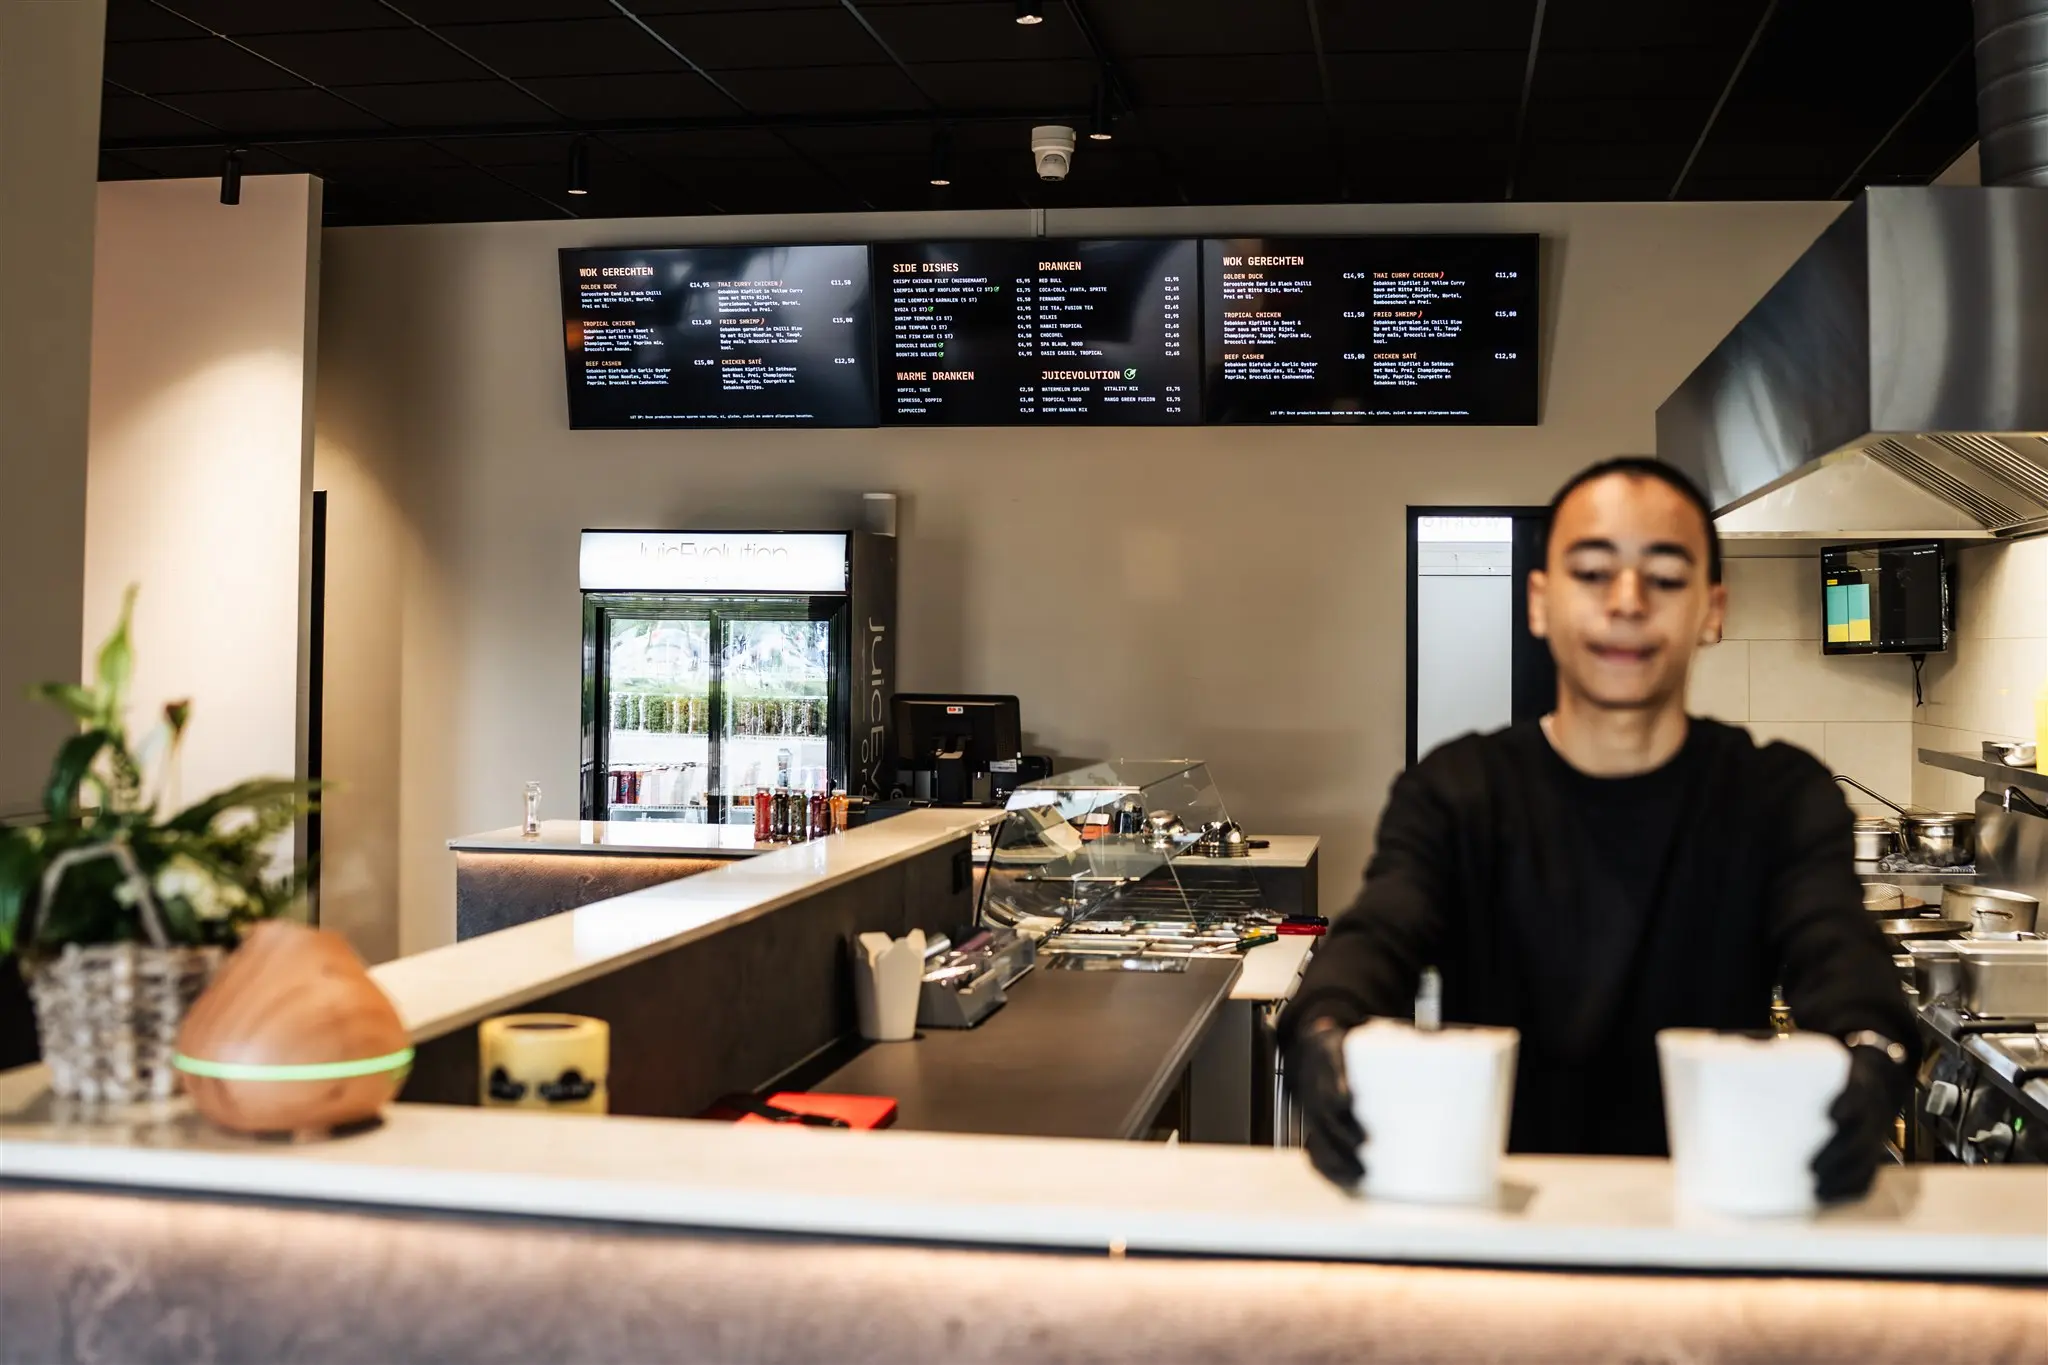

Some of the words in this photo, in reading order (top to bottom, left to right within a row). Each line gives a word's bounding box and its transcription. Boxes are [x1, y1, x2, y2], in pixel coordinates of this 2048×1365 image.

[1223, 257, 1241, 266] WOK
[1248, 257, 1304, 265] GERECHTEN
[602, 268, 653, 276] GERECHTEN
[893, 264, 917, 272] SIDE
[923, 264, 958, 272] DISHES
[1042, 371, 1120, 379] JUICEVOLUTION
